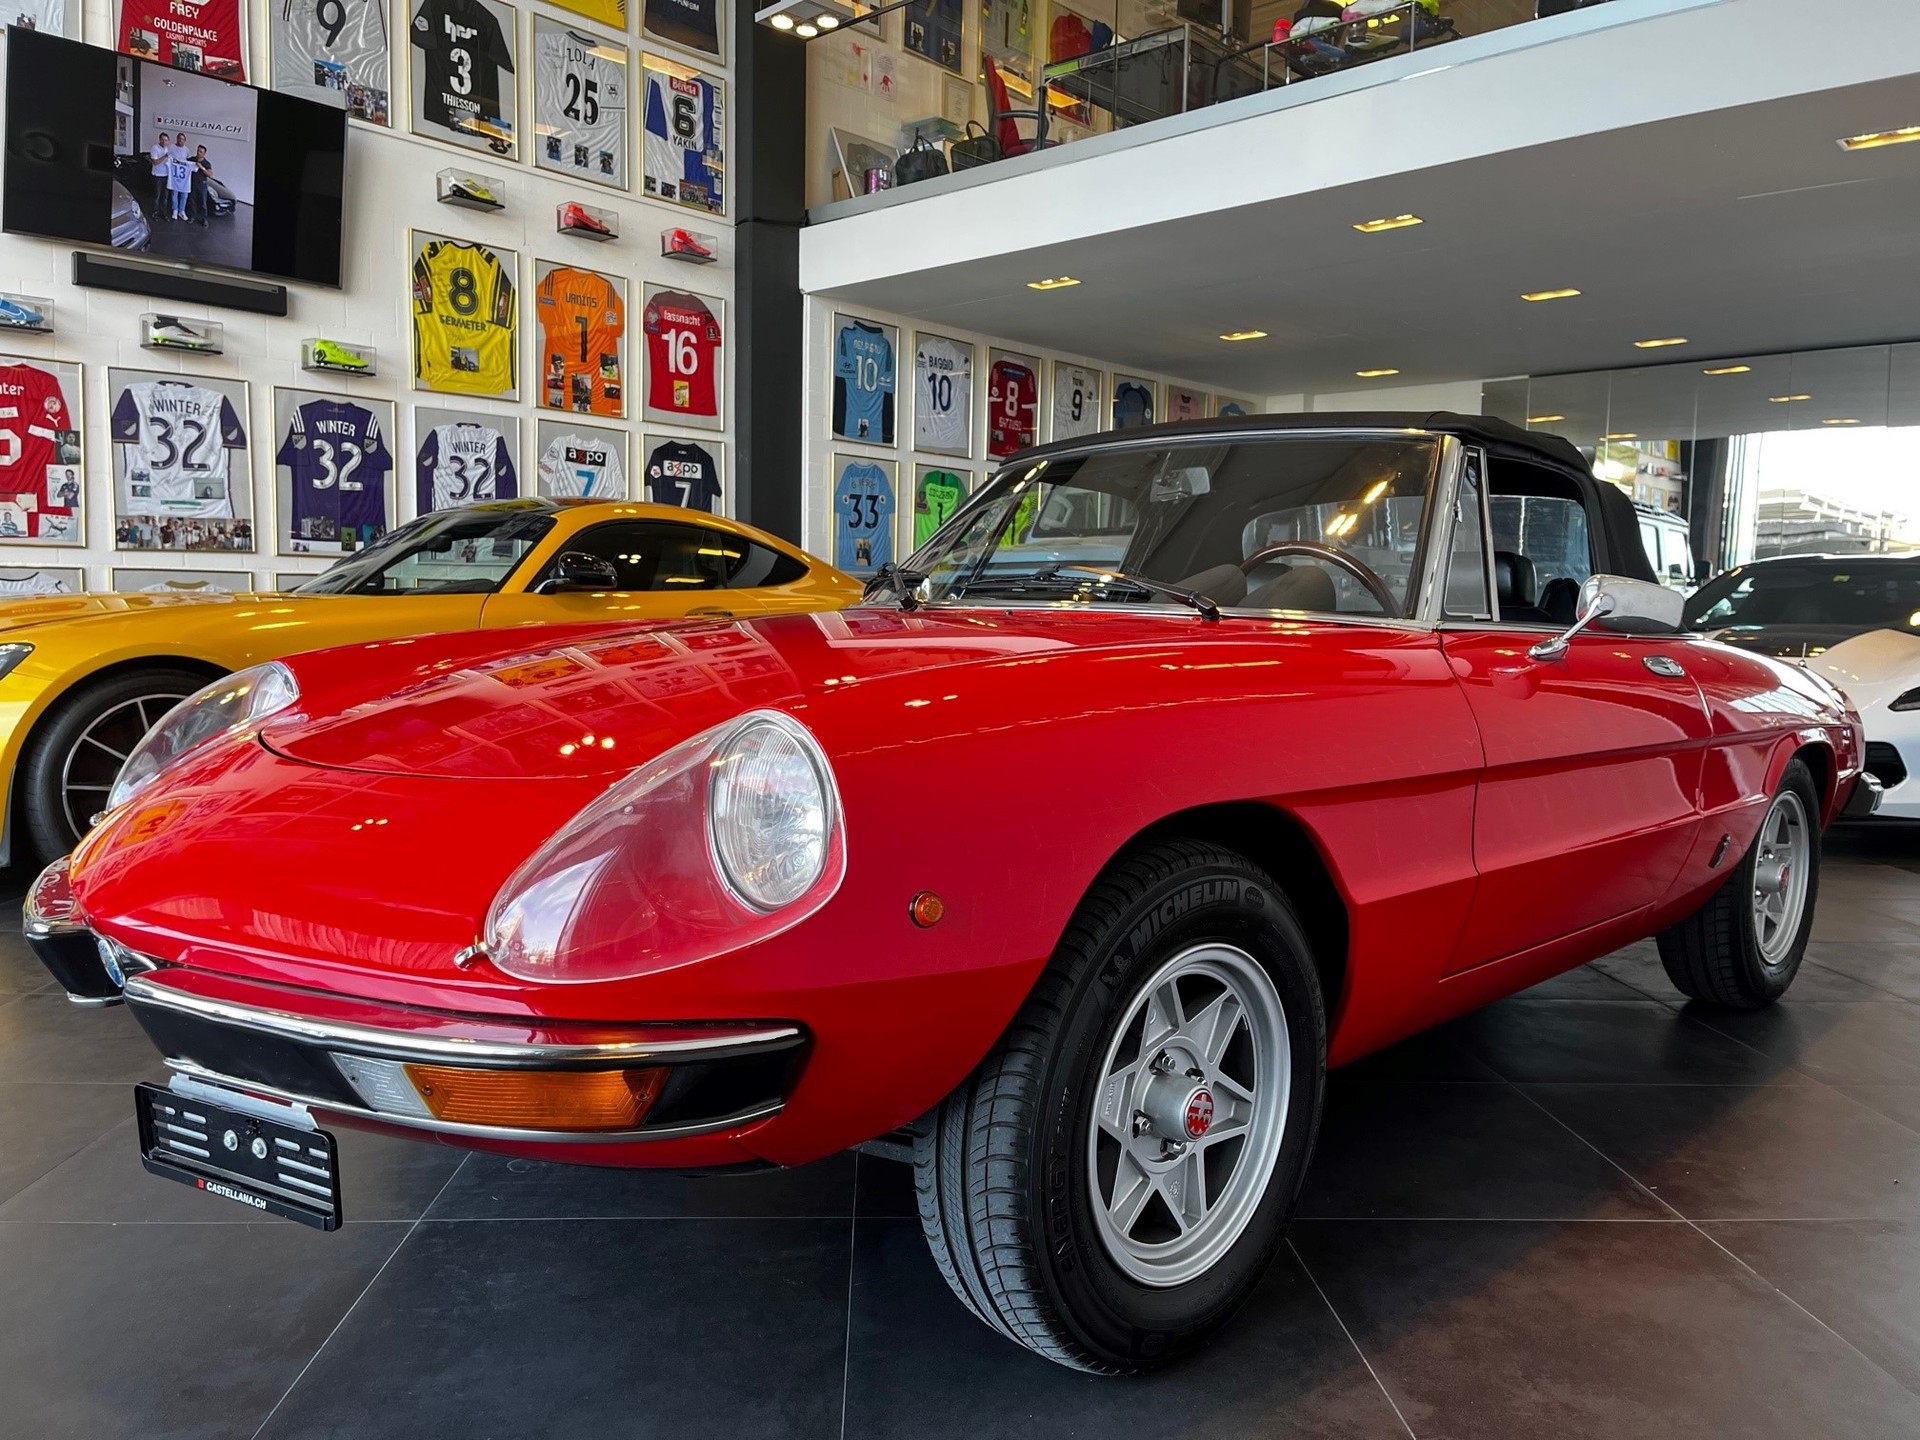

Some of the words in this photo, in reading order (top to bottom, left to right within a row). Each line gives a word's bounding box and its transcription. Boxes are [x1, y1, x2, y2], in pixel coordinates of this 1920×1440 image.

[169, 1, 200, 19] FREY
[316, 0, 347, 47] 9
[153, 16, 218, 42] GOLDENPALACE
[450, 47, 472, 95] 3
[441, 92, 480, 114] THIESSON
[563, 72, 599, 126] 25
[673, 94, 697, 140] 6
[163, 117, 242, 134] CASTELLANA.CH
[672, 134, 697, 150] YAKIN
[448, 266, 480, 316] 8
[575, 315, 588, 363] 1
[661, 328, 698, 375] 16
[855, 354, 878, 393] 10
[928, 355, 953, 371] BAGGIO
[153, 399, 201, 416] WINTER
[927, 372, 952, 412] 10
[1004, 381, 1019, 417] 8
[1071, 389, 1083, 422] 9
[149, 416, 211, 471] 32
[315, 420, 356, 437] WINTER
[312, 438, 364, 491] 32
[451, 440, 487, 455] WINTER
[449, 455, 494, 501] 32
[576, 469, 597, 498] 7
[675, 481, 692, 508] 7
[848, 493, 879, 529] 33
[1129, 879, 1240, 954] MICHELIN
[206, 1181, 267, 1210] CASTELLANA.CH
